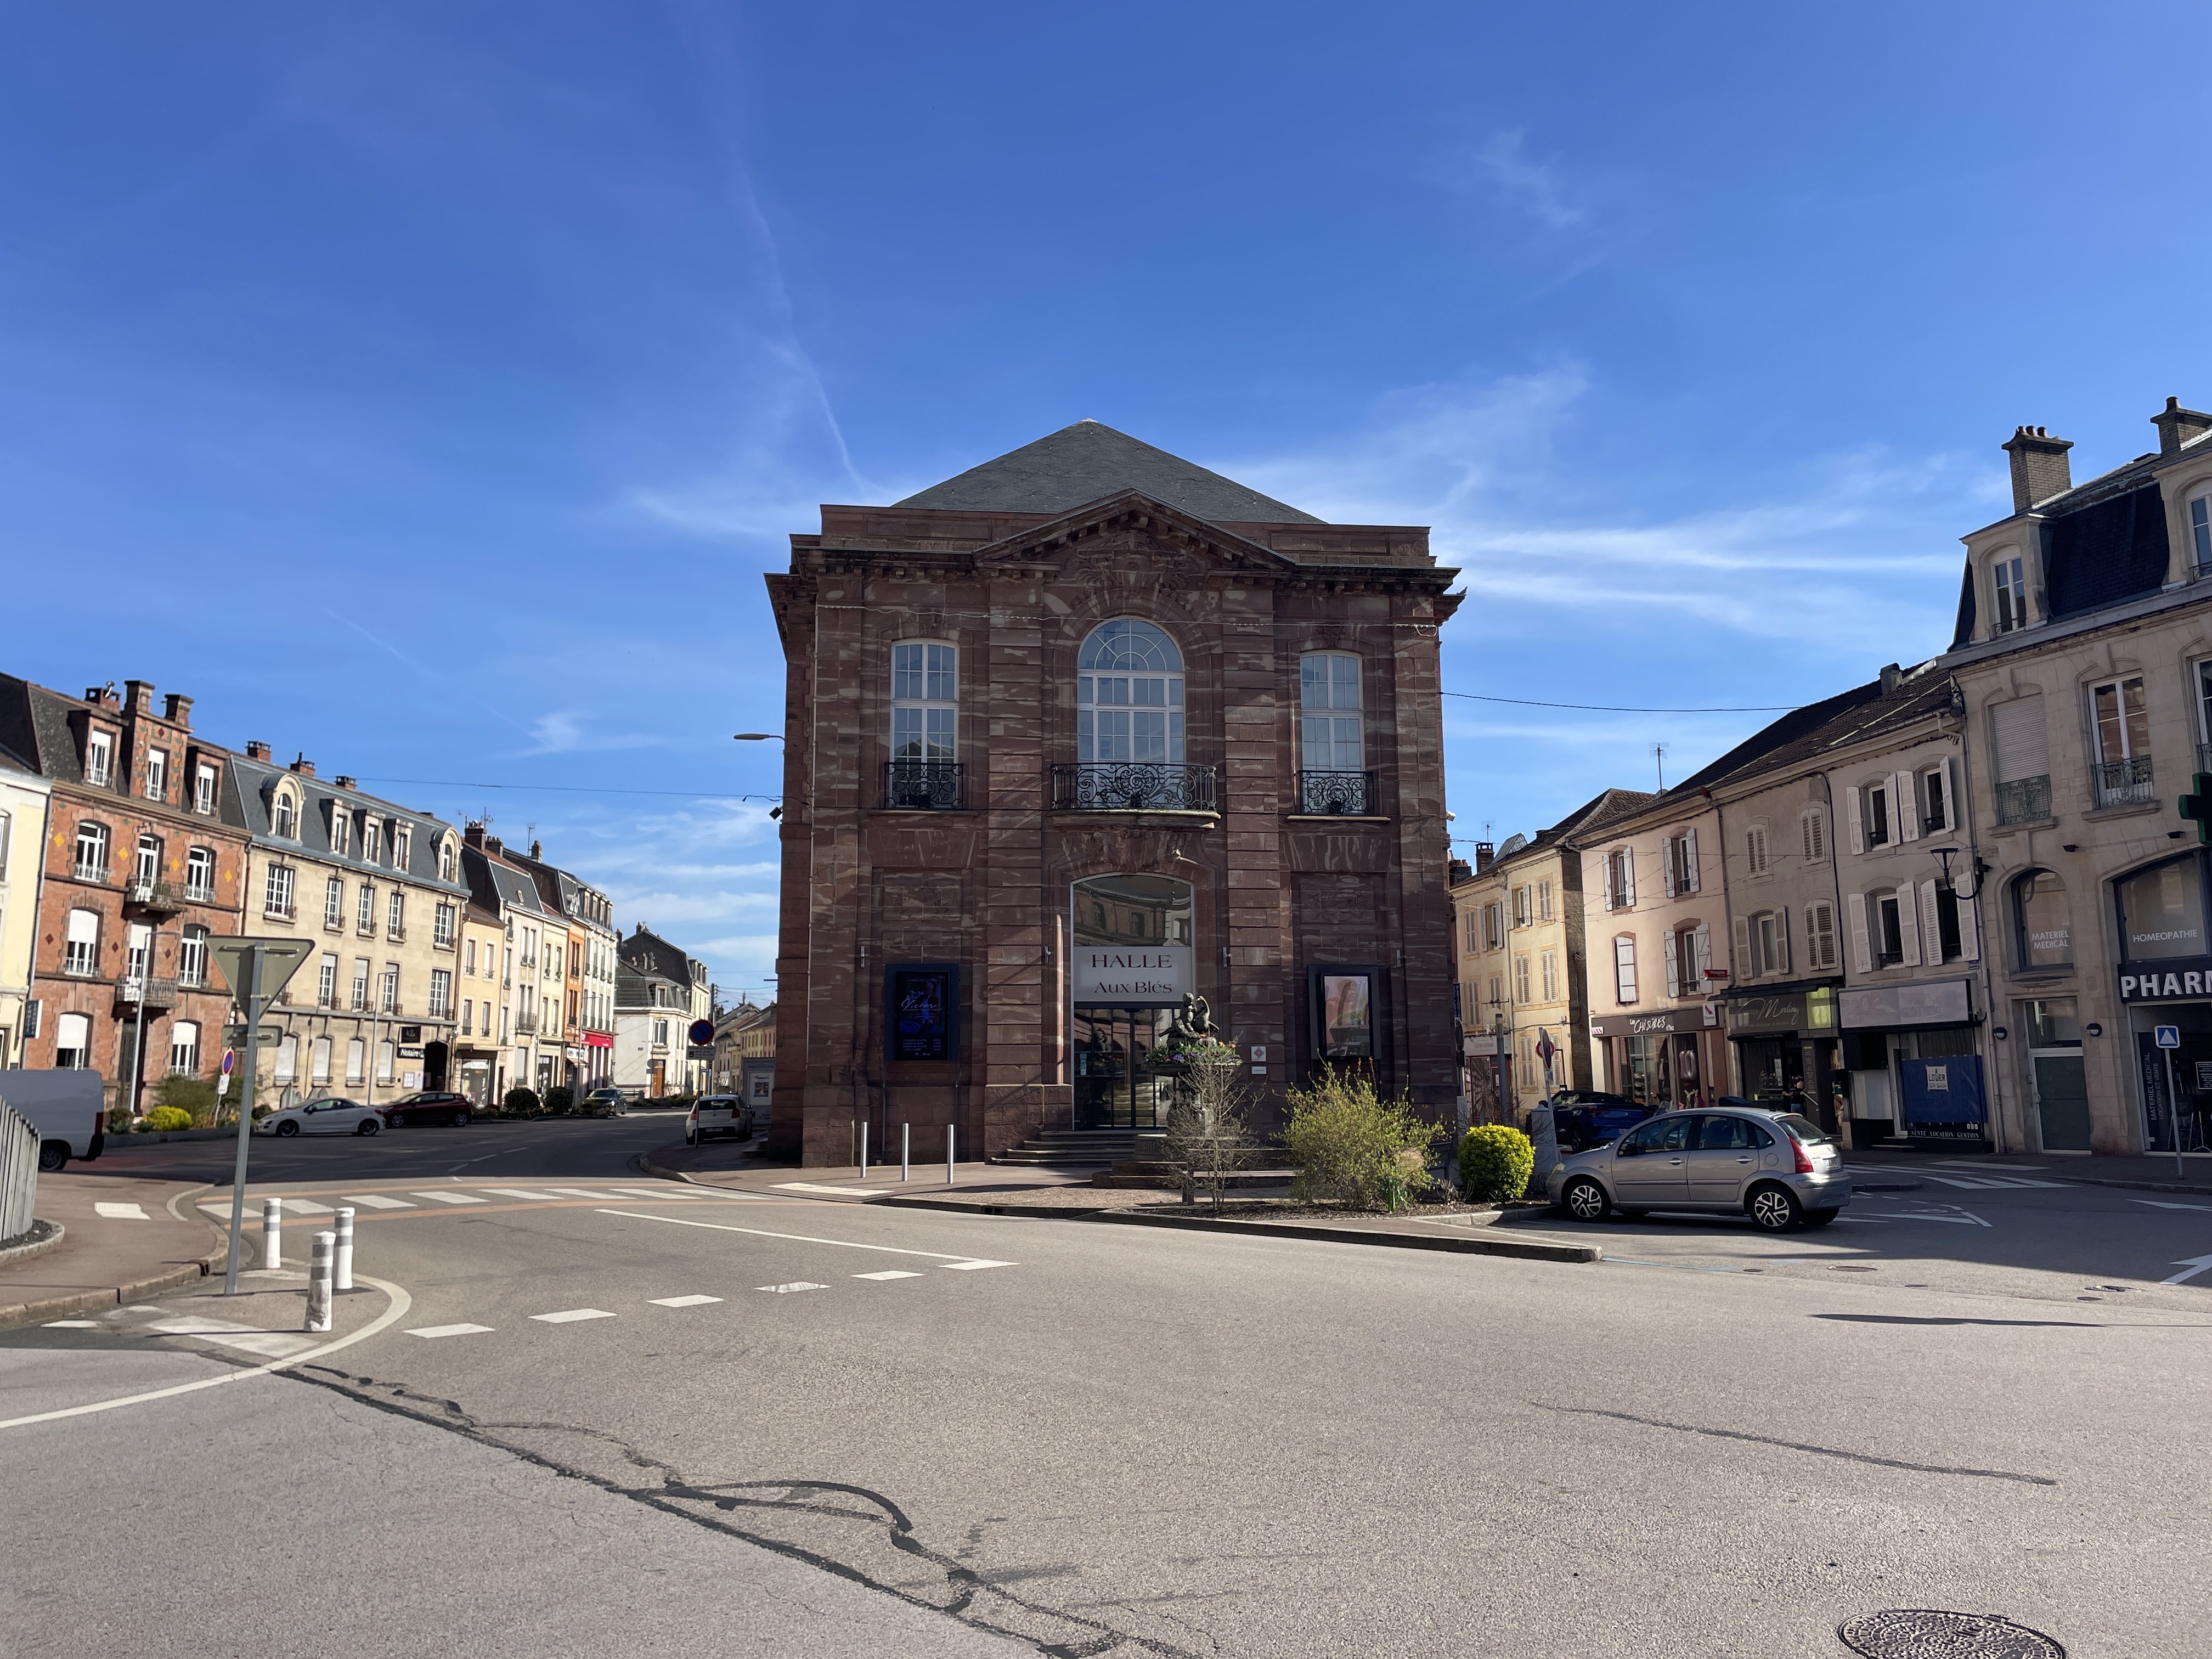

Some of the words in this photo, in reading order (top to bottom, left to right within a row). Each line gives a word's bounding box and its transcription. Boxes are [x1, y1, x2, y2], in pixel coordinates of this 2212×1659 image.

[2032, 930, 2069, 941] MATERIEL
[2132, 929, 2198, 943] HOMEOPATHIE
[2034, 939, 2069, 950] MEDICAL
[1091, 954, 1172, 968] HALLE
[1093, 981, 1130, 994] Aux
[1135, 980, 1172, 994] Blés
[2148, 1085, 2157, 1120] MATERIEL
